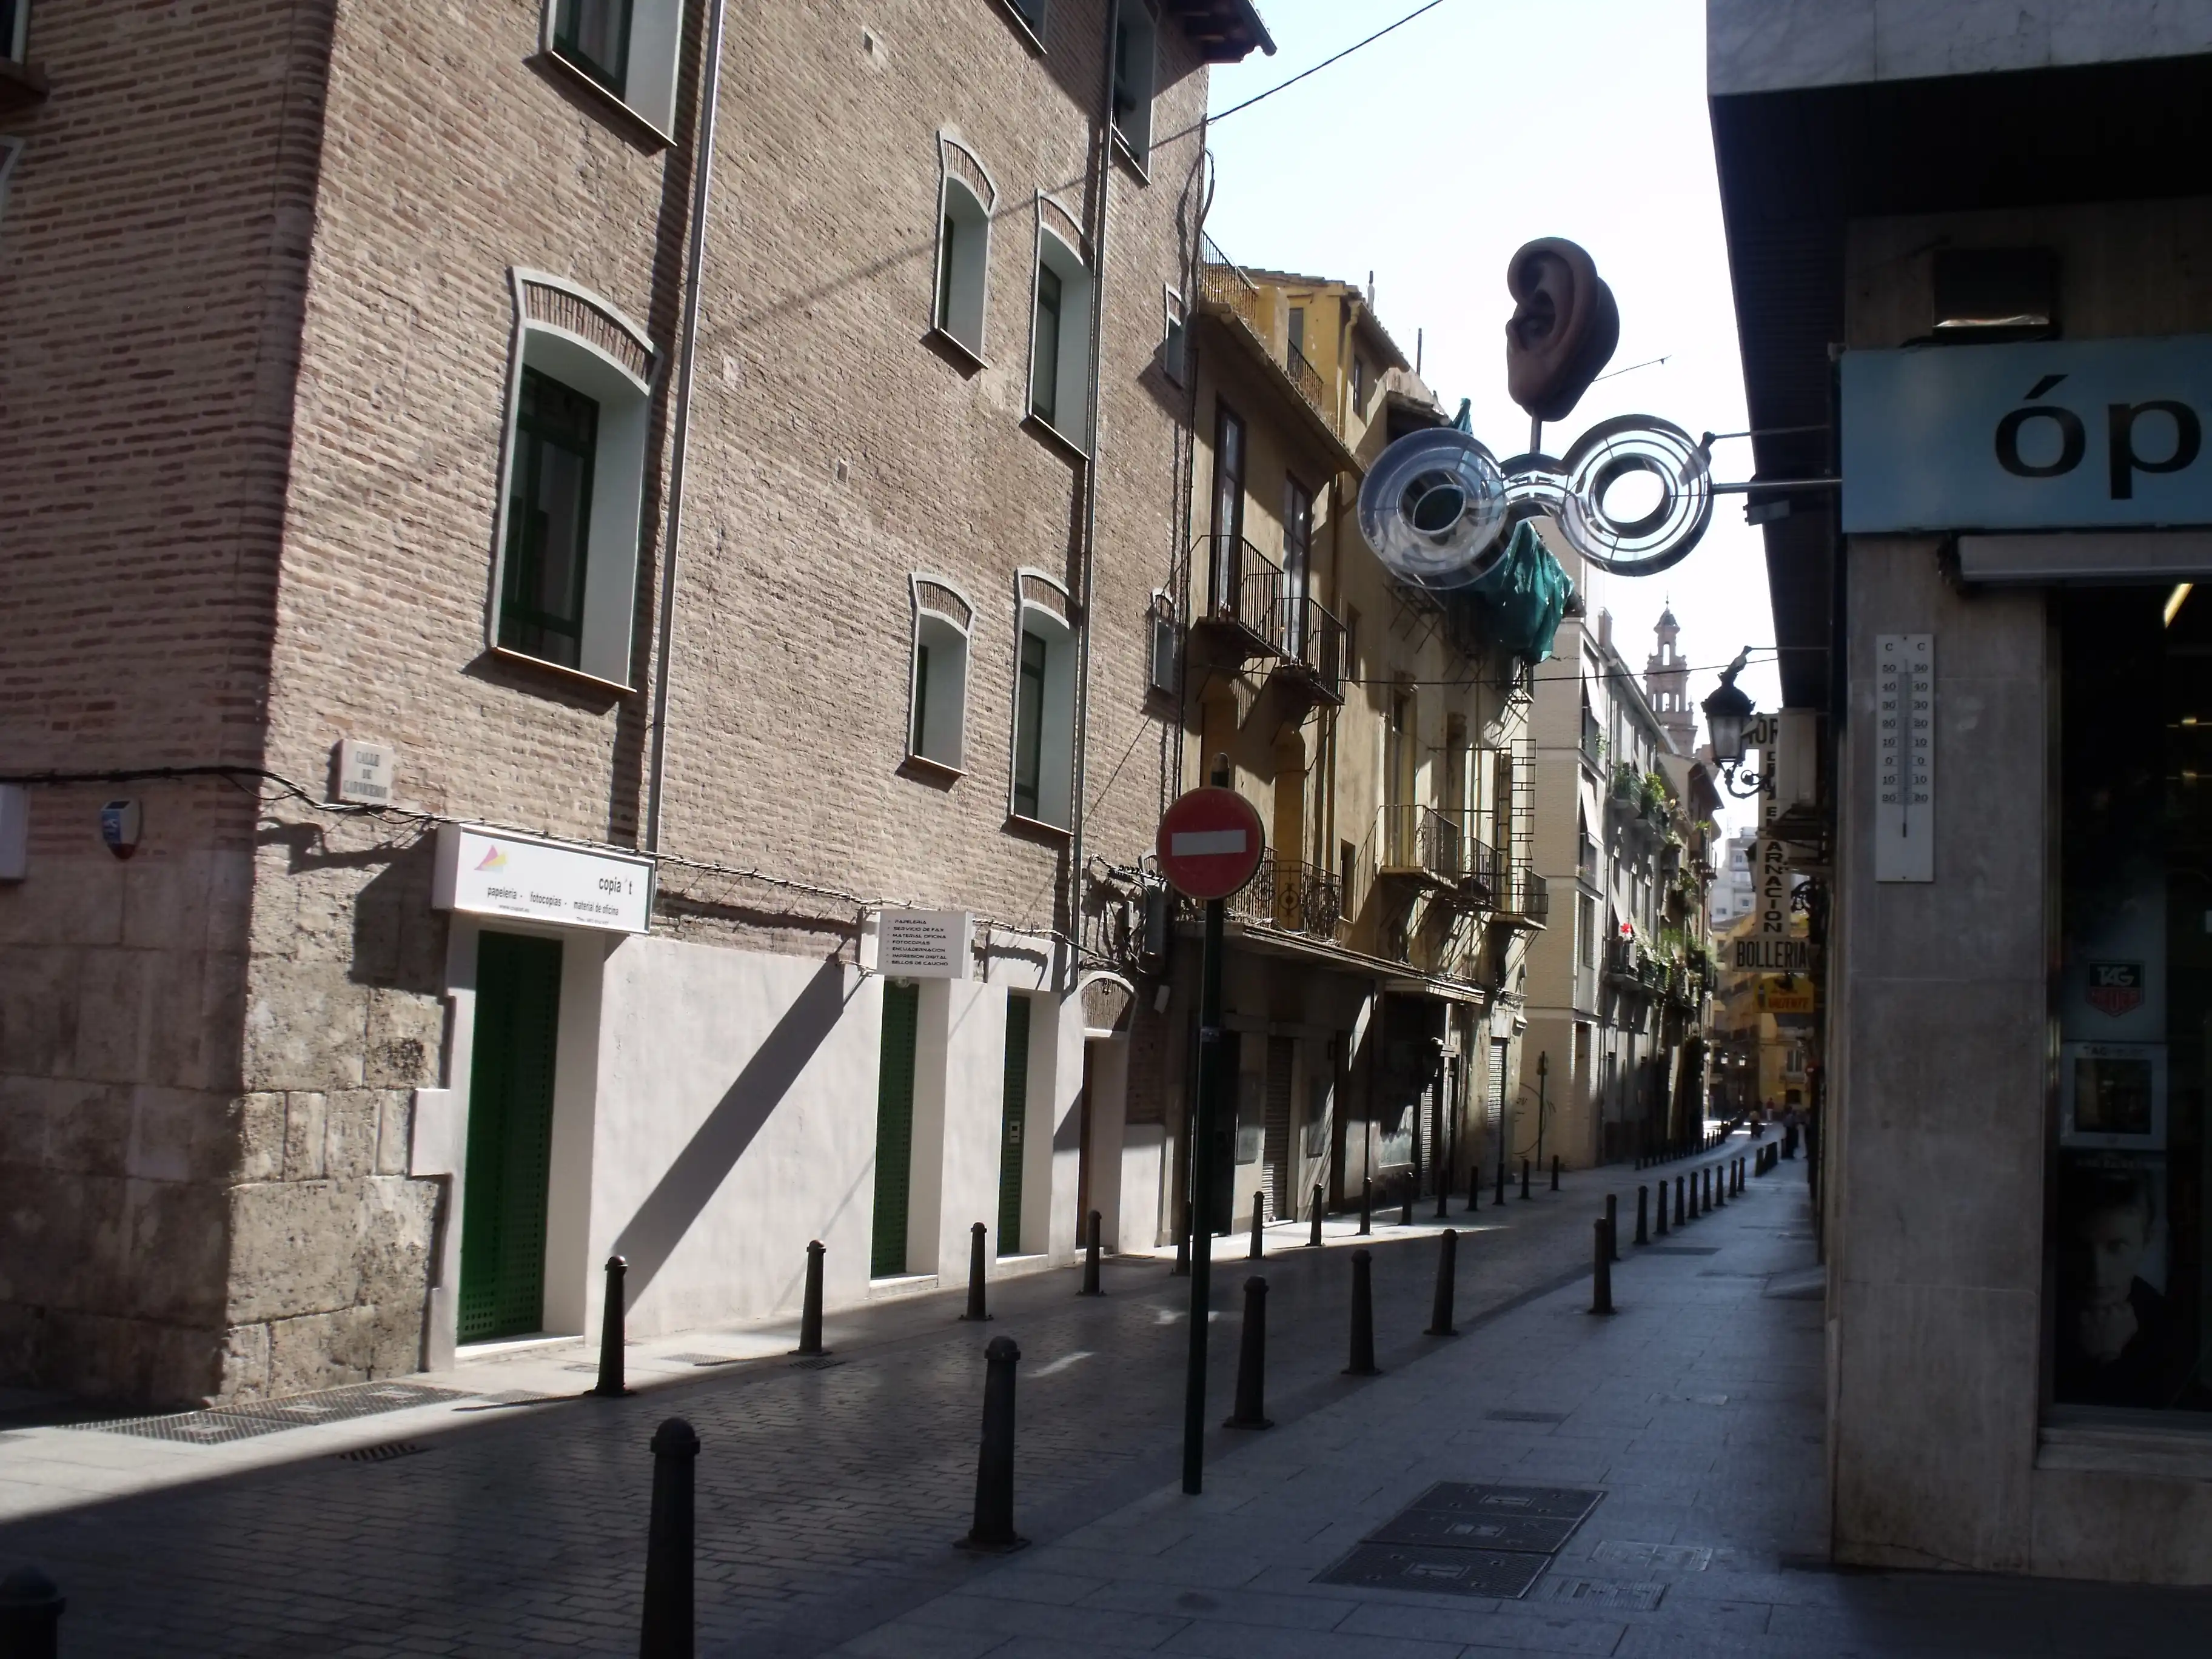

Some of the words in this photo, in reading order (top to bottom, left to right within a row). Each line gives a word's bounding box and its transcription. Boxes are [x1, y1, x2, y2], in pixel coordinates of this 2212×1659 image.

[1995, 374, 2202, 500] óp
[357, 751, 380, 766] CALLE
[363, 769, 372, 779] DE
[530, 891, 561, 908] fotocopias
[574, 900, 594, 913] material
[595, 903, 602, 914] de
[602, 903, 619, 916] oficina
[1737, 940, 1807, 968] BOLLERIA
[2096, 965, 2136, 987] TAG
